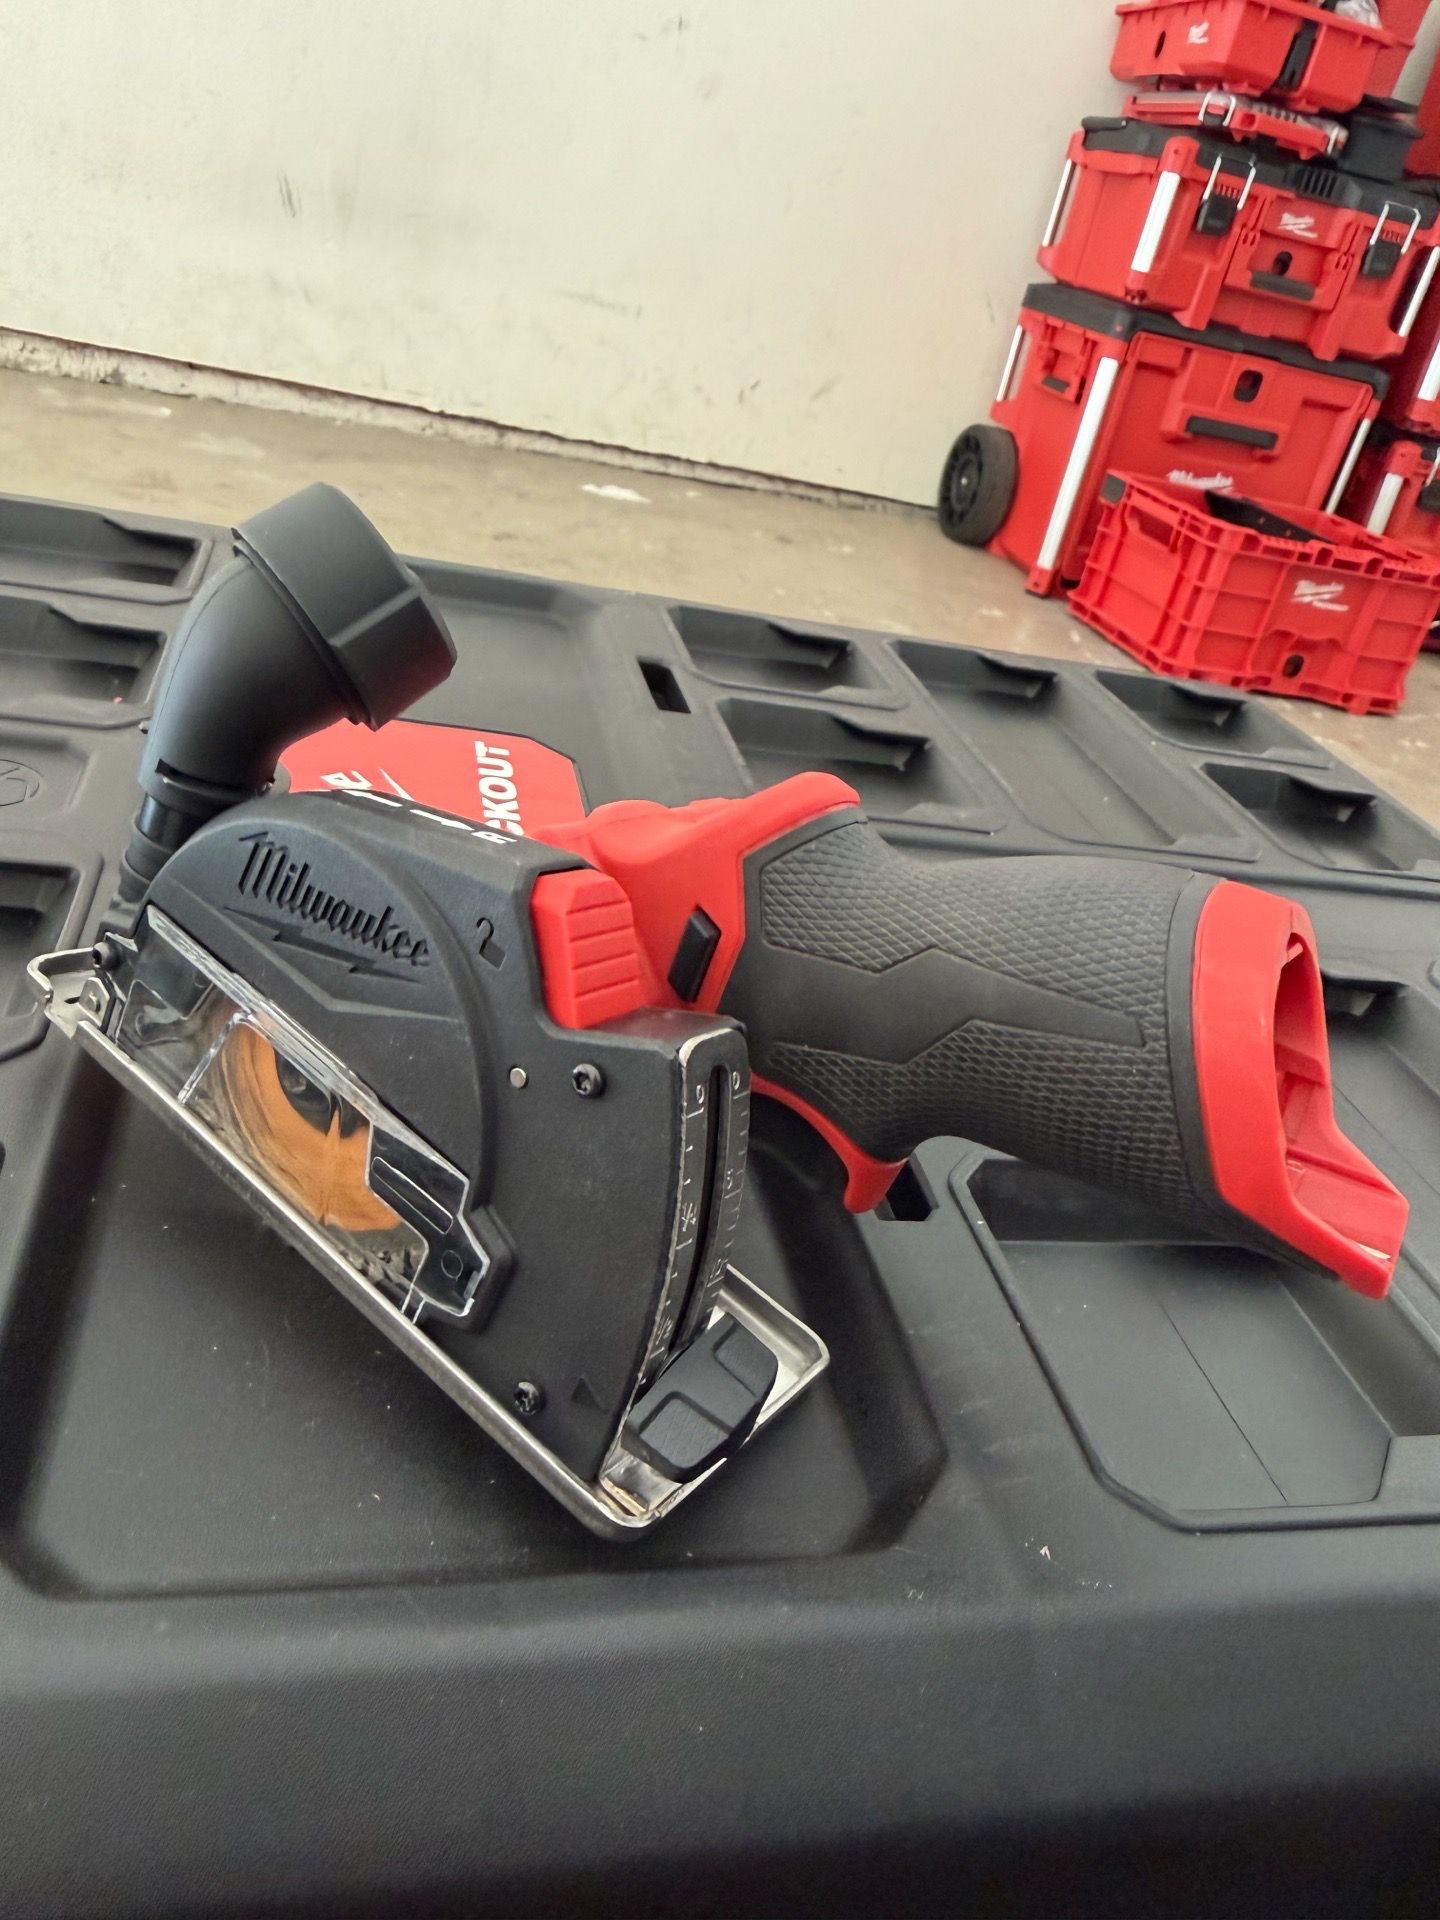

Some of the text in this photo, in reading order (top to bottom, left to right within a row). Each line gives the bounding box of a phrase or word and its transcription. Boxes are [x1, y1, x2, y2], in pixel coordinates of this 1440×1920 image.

[238, 831, 430, 967] Milwaukee
[732, 1071, 741, 1091] 0
[696, 1084, 705, 1104] 0
